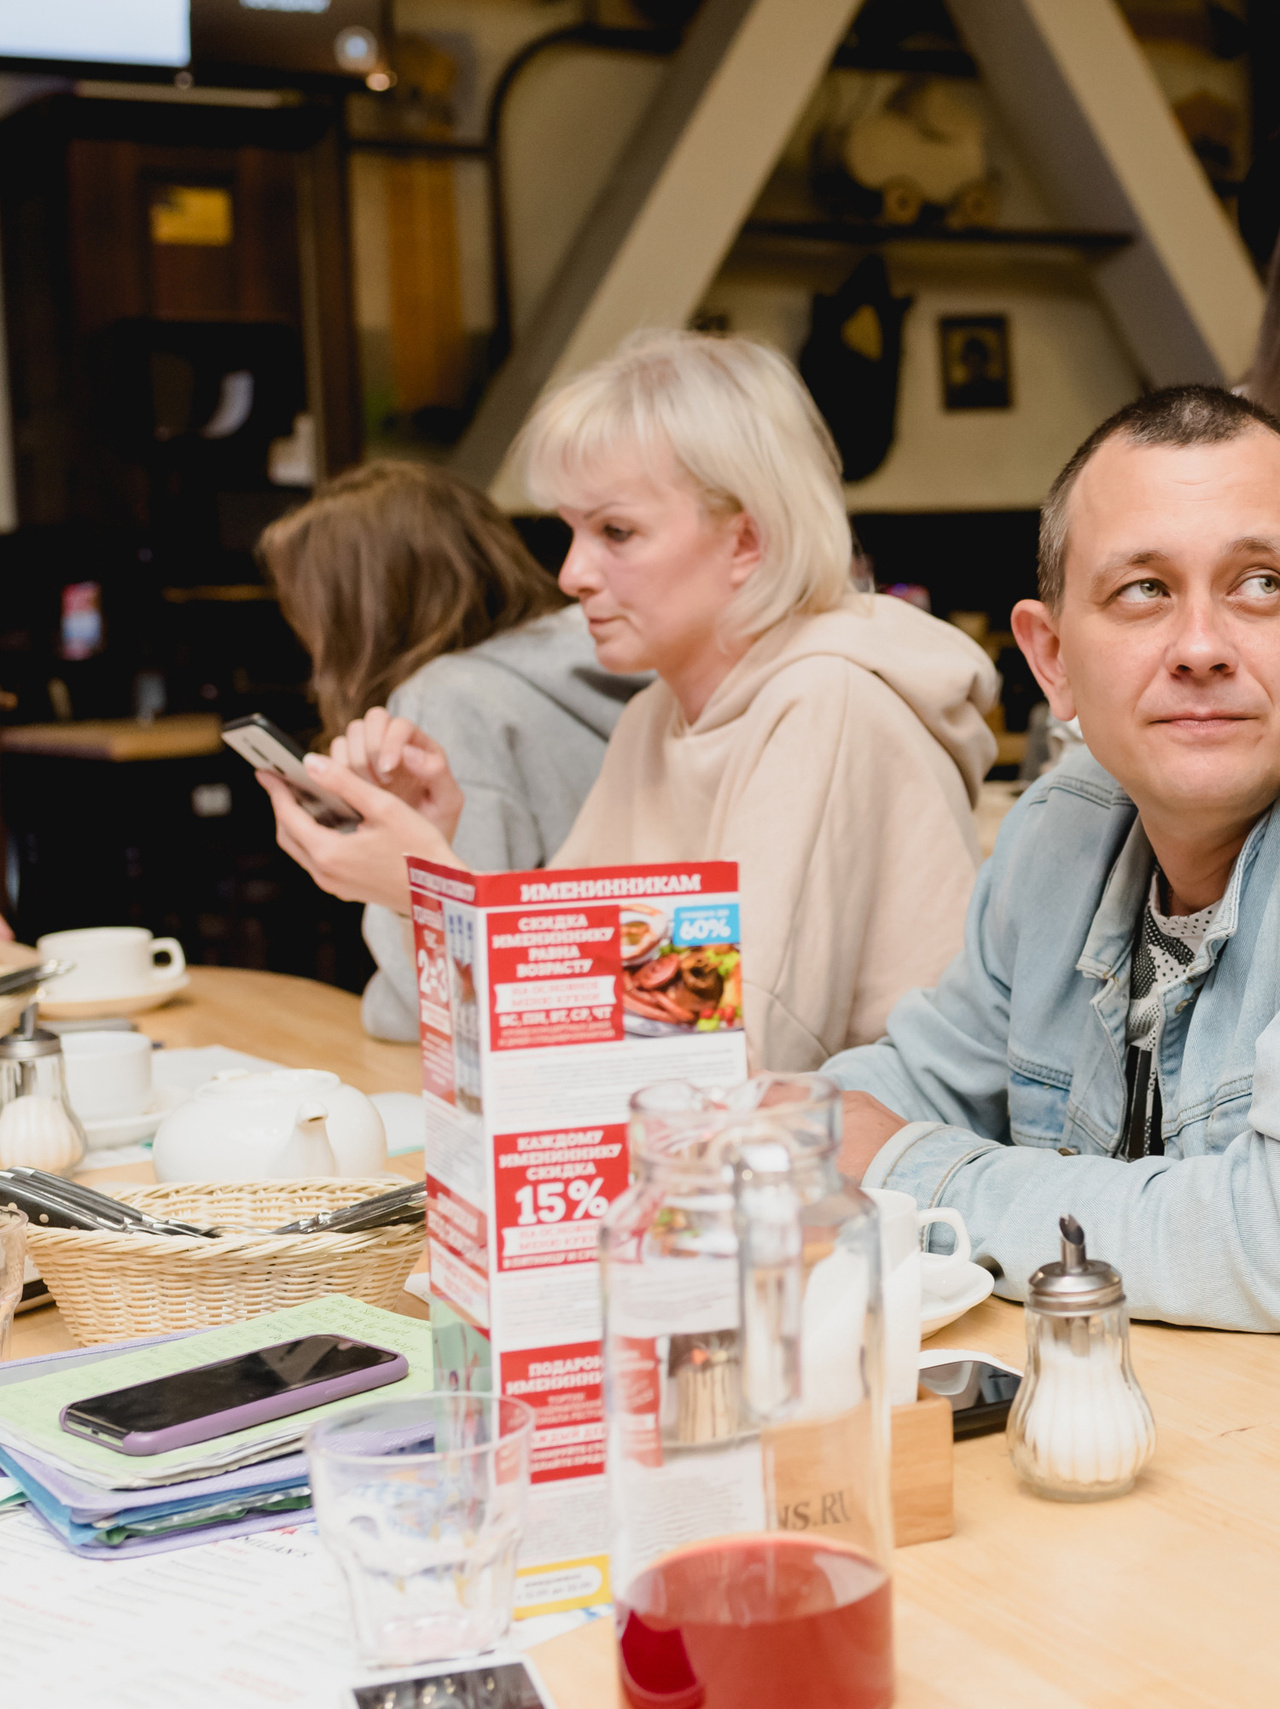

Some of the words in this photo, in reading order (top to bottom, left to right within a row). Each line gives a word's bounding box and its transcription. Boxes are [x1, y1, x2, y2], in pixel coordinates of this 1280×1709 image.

[520, 874, 702, 902] ИМЕНИННИКАМ
[518, 914, 588, 932] СКИДКА
[679, 918, 731, 941] 60%
[492, 927, 615, 949] ИМЕНИННИКУ
[528, 945, 581, 962] РАВНА
[516, 959, 594, 978] ВОЗРАСТУ
[517, 1130, 604, 1151] КАЖДОМУ
[498, 1143, 623, 1168] ИМЕНИННИКУ
[526, 1161, 597, 1181] СКИДКА
[515, 1177, 609, 1225] 15%
